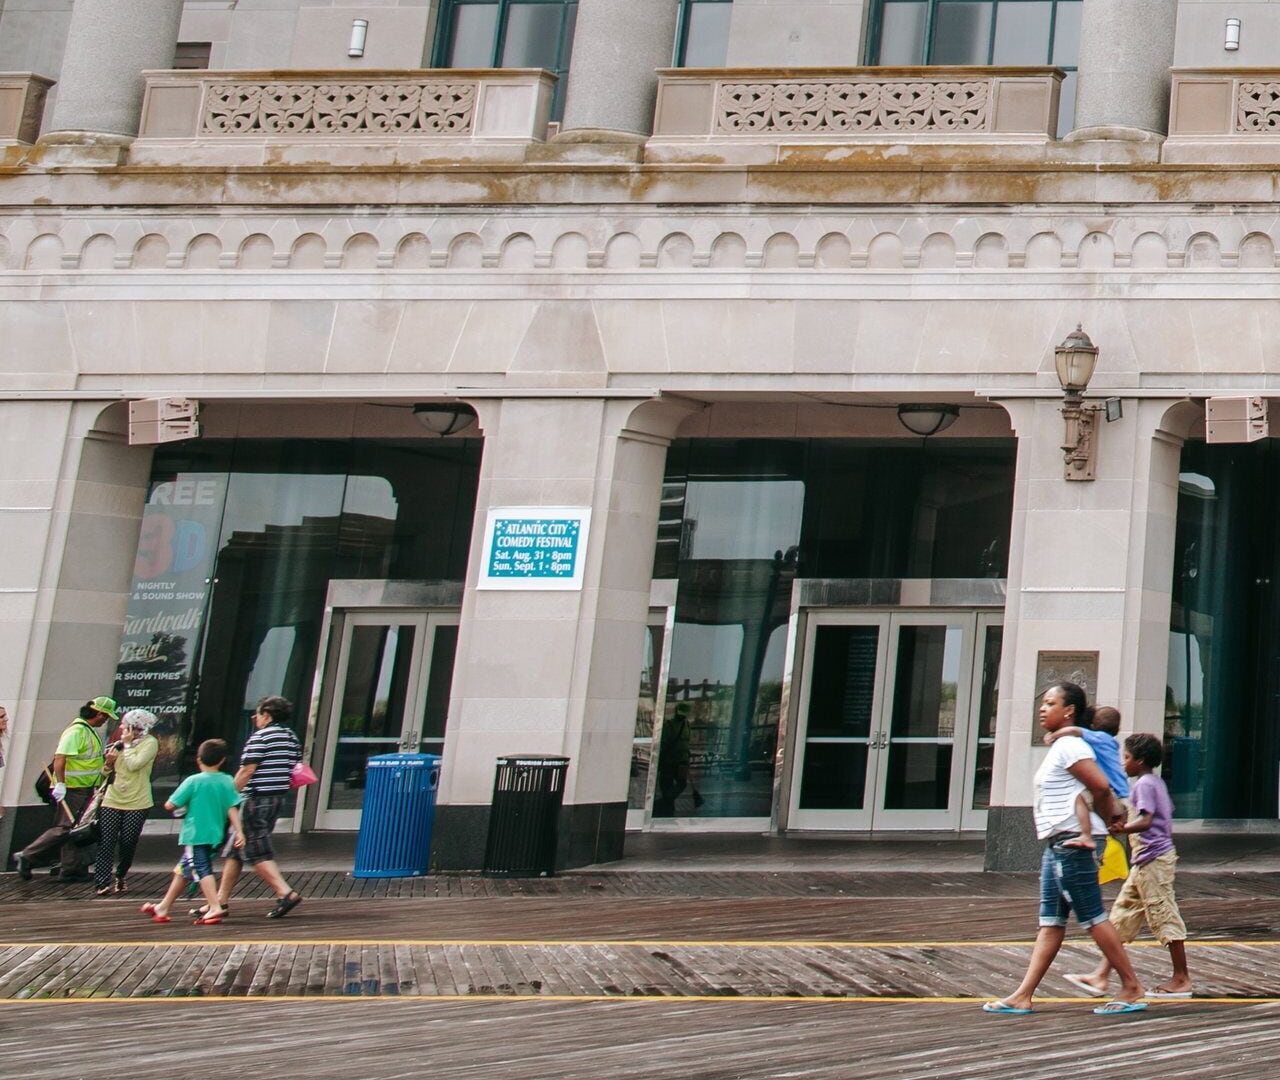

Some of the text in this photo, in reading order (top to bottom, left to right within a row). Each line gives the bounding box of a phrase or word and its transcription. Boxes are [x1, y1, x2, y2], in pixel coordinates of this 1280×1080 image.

[150, 481, 217, 505] REE
[505, 523, 569, 535] ATLANTIC CITY
[497, 536, 573, 548] COMEDY FESTIVAL
[495, 550, 572, 563] Sat. Aug. 31 8pm
[493, 561, 512, 571] Sun.
[514, 561, 536, 573] Sept.
[551, 561, 571, 574] 8pm
[137, 582, 176, 590] NIGHTLY
[142, 592, 175, 600] SOUND
[175, 592, 205, 600] SHOW
[124, 672, 181, 680] SHOWTIMES
[127, 689, 151, 697] VISIT
